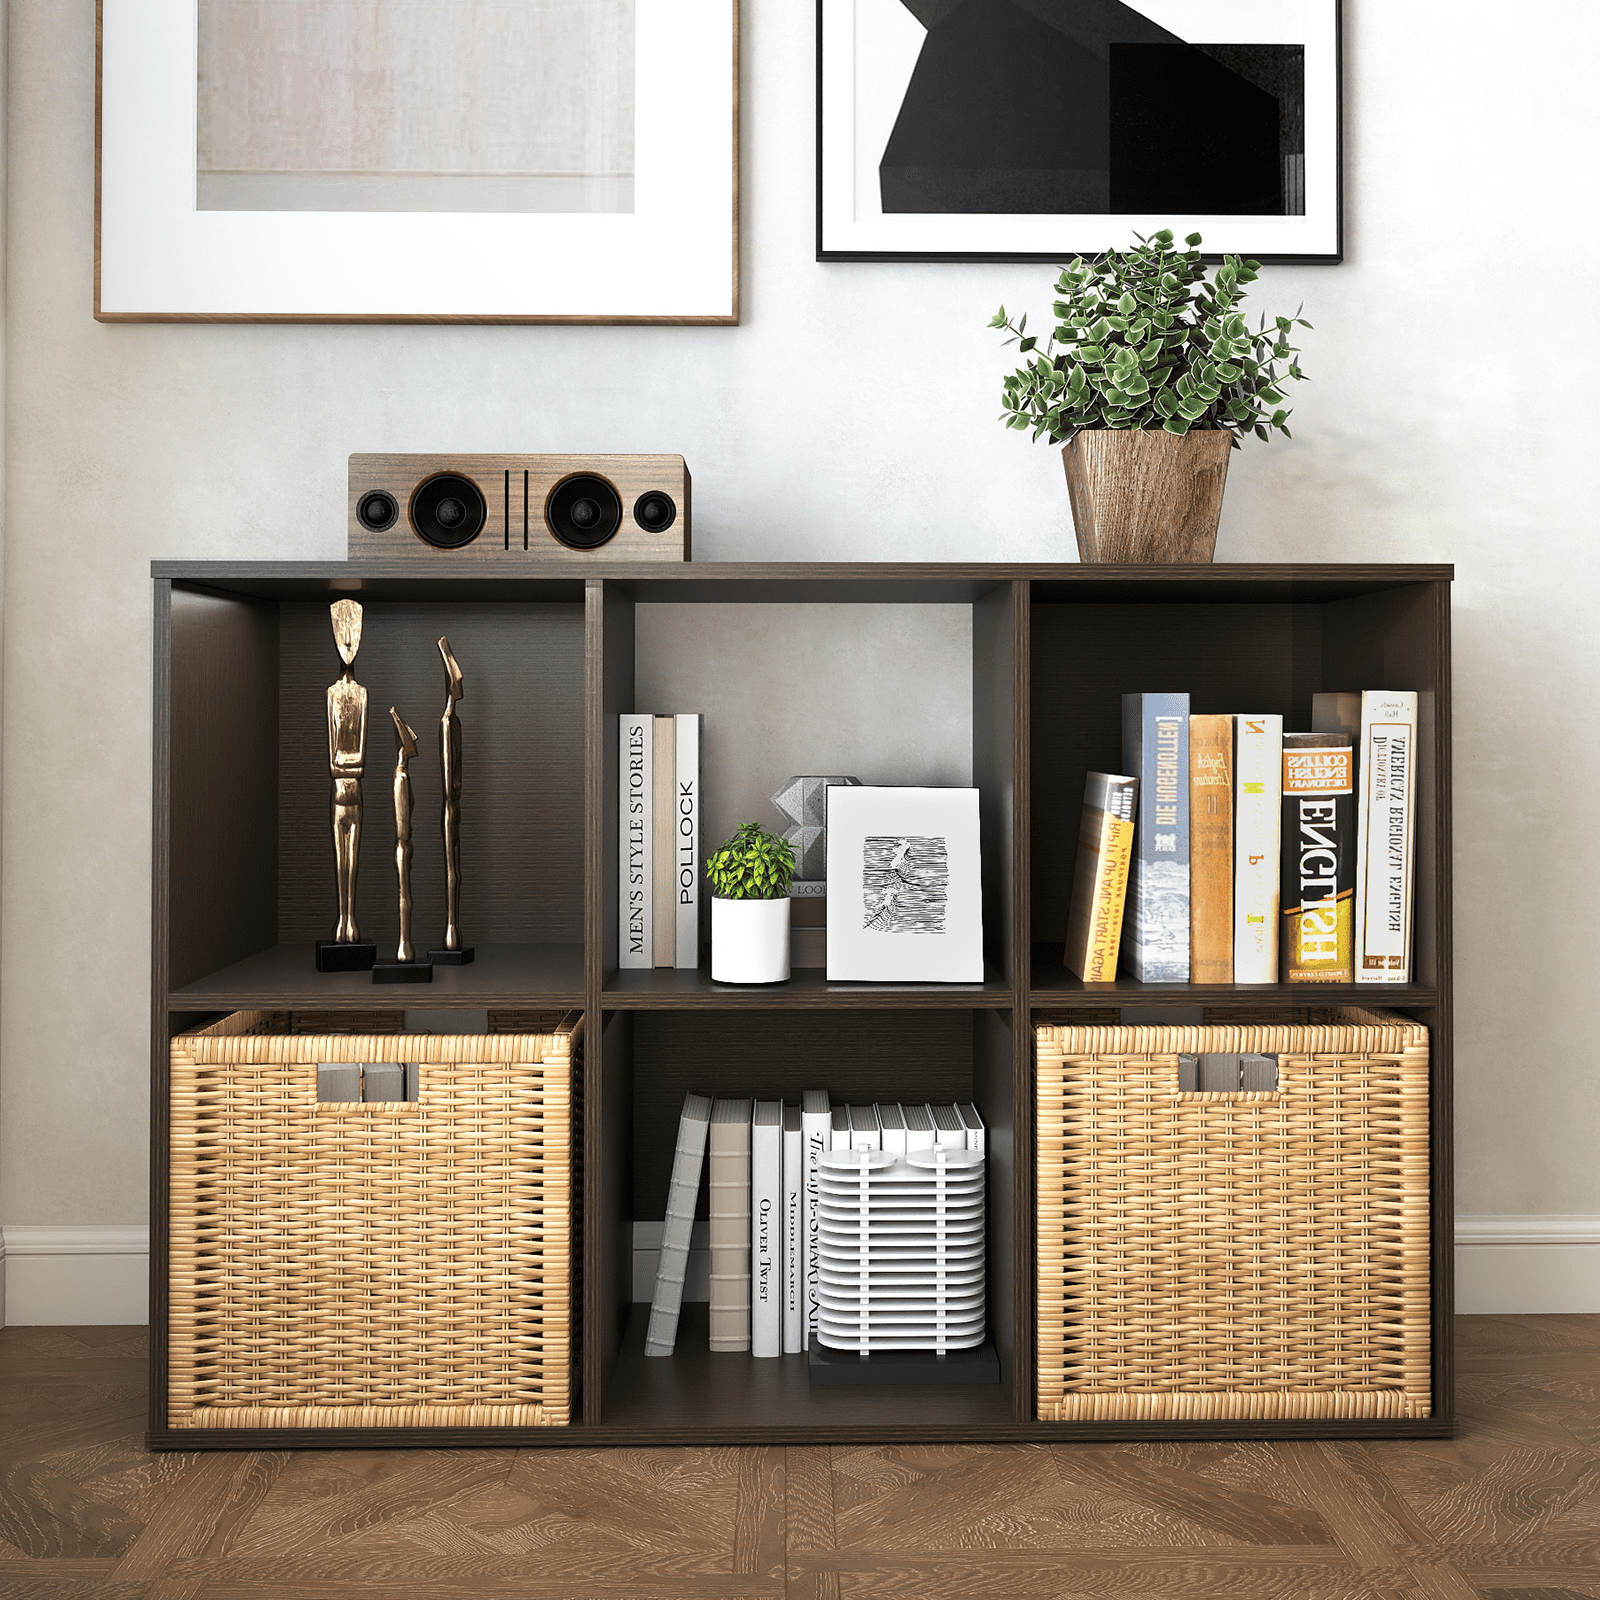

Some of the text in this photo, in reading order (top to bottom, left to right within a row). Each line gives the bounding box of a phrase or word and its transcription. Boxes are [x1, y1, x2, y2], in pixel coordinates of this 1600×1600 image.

[629, 725, 644, 813] STORIES
[629, 818, 644, 885] STYLE
[680, 781, 693, 904] POLLOCK
[809, 1131, 824, 1165] The
[759, 1198, 771, 1302] OLIVER TWIST
[789, 1190, 797, 1311] MIDDLEMARCH
